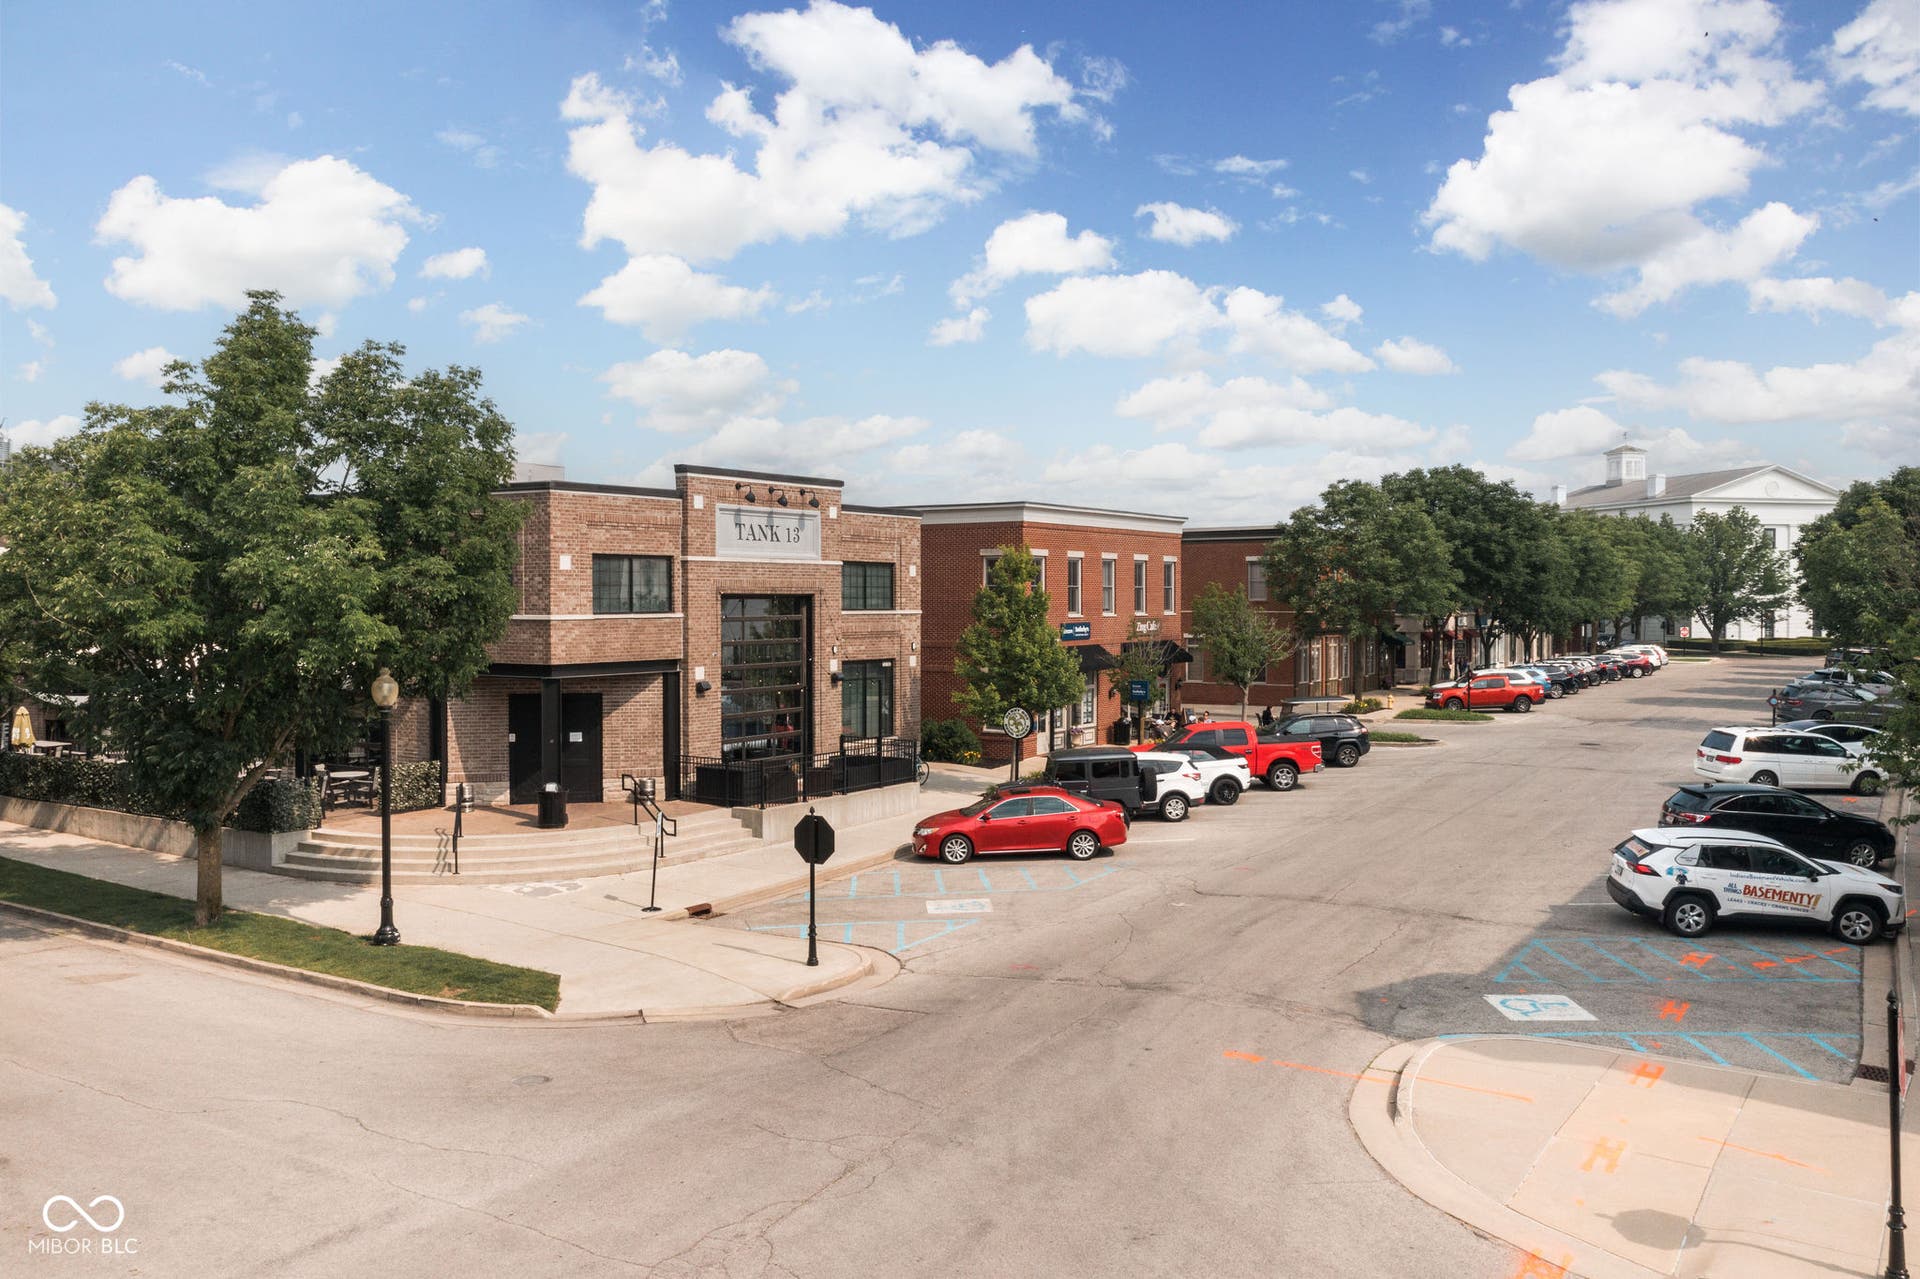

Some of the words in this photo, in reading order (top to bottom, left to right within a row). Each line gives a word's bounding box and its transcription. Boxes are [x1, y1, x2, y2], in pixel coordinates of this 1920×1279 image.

[735, 522, 780, 543] TANK
[786, 527, 800, 543] 13
[1742, 884, 1823, 911] BASEMENTY!
